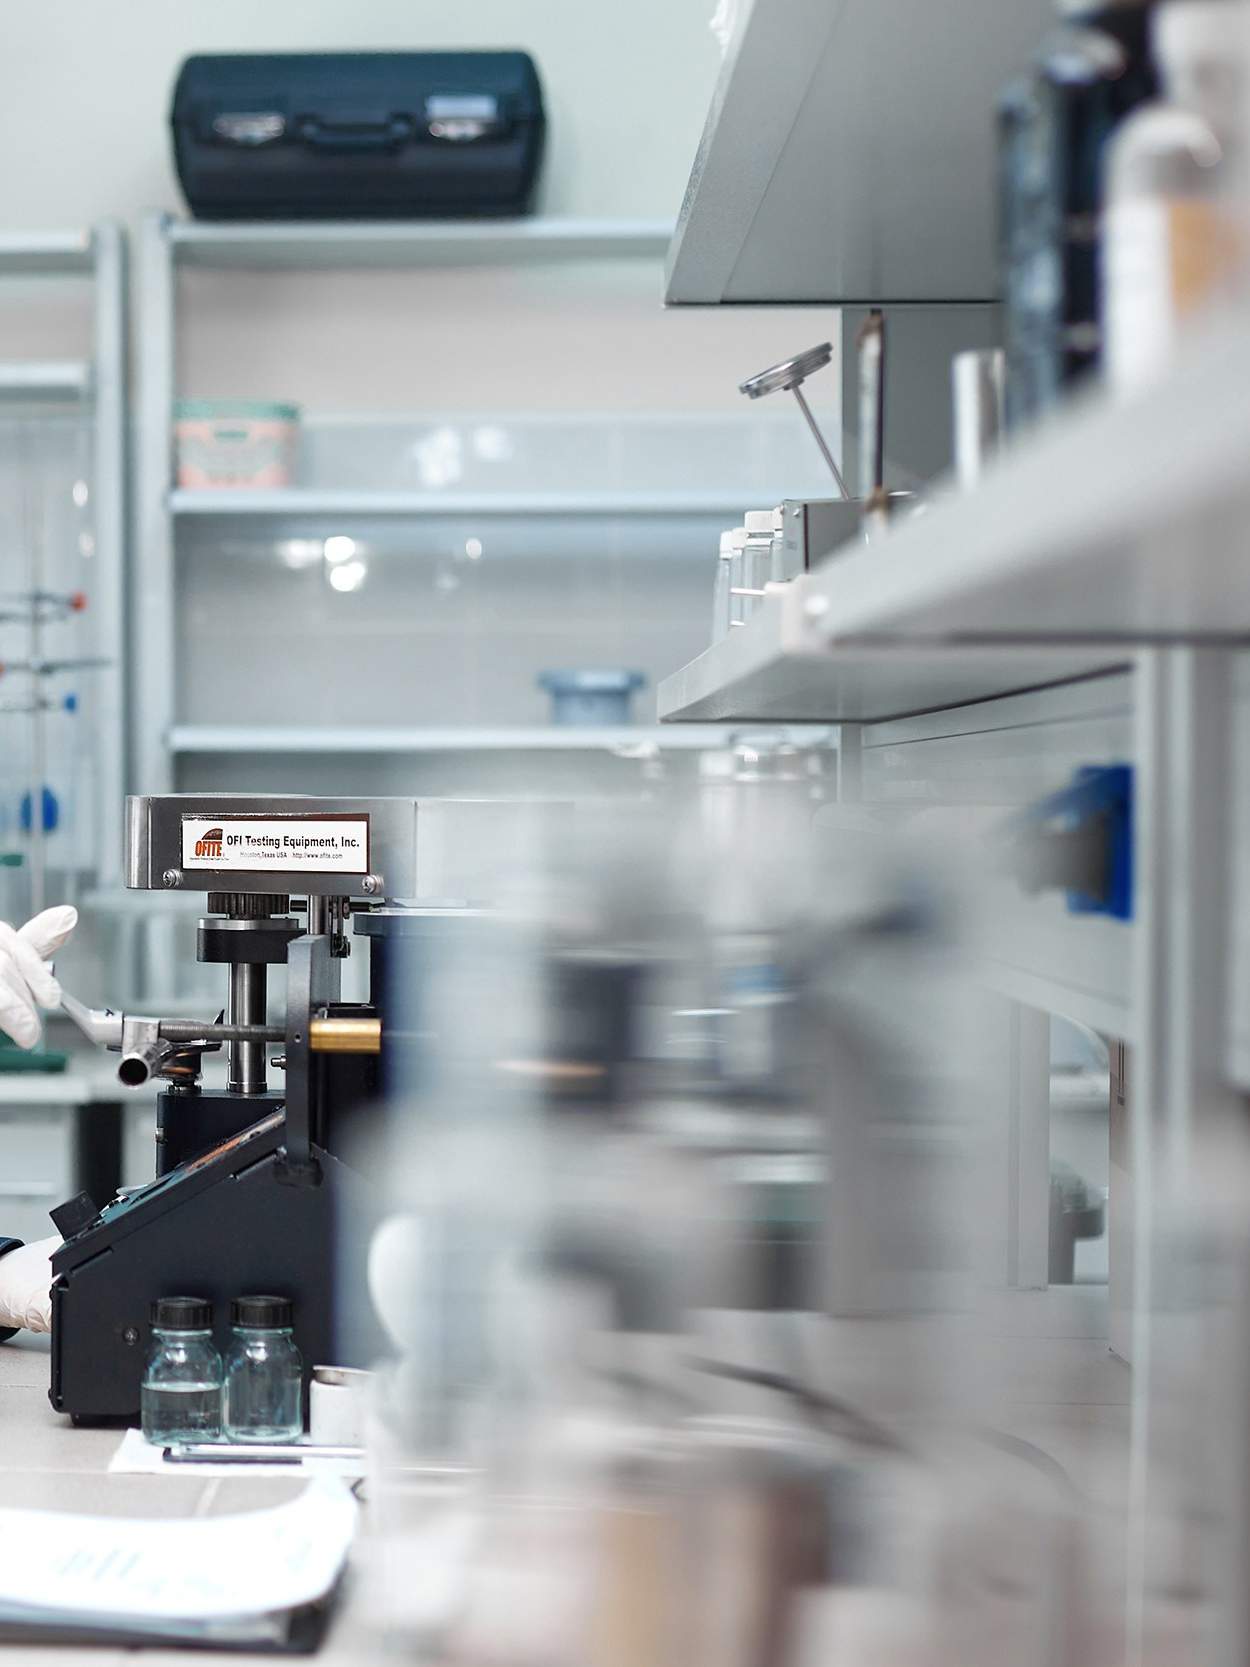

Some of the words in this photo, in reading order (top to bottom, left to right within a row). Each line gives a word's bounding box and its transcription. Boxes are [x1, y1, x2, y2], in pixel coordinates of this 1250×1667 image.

[194, 840, 223, 857] OFITE
[226, 835, 243, 846] OFI
[245, 836, 280, 849] Testing
[283, 836, 338, 849] Equipment,
[341, 836, 360, 847] Inc.
